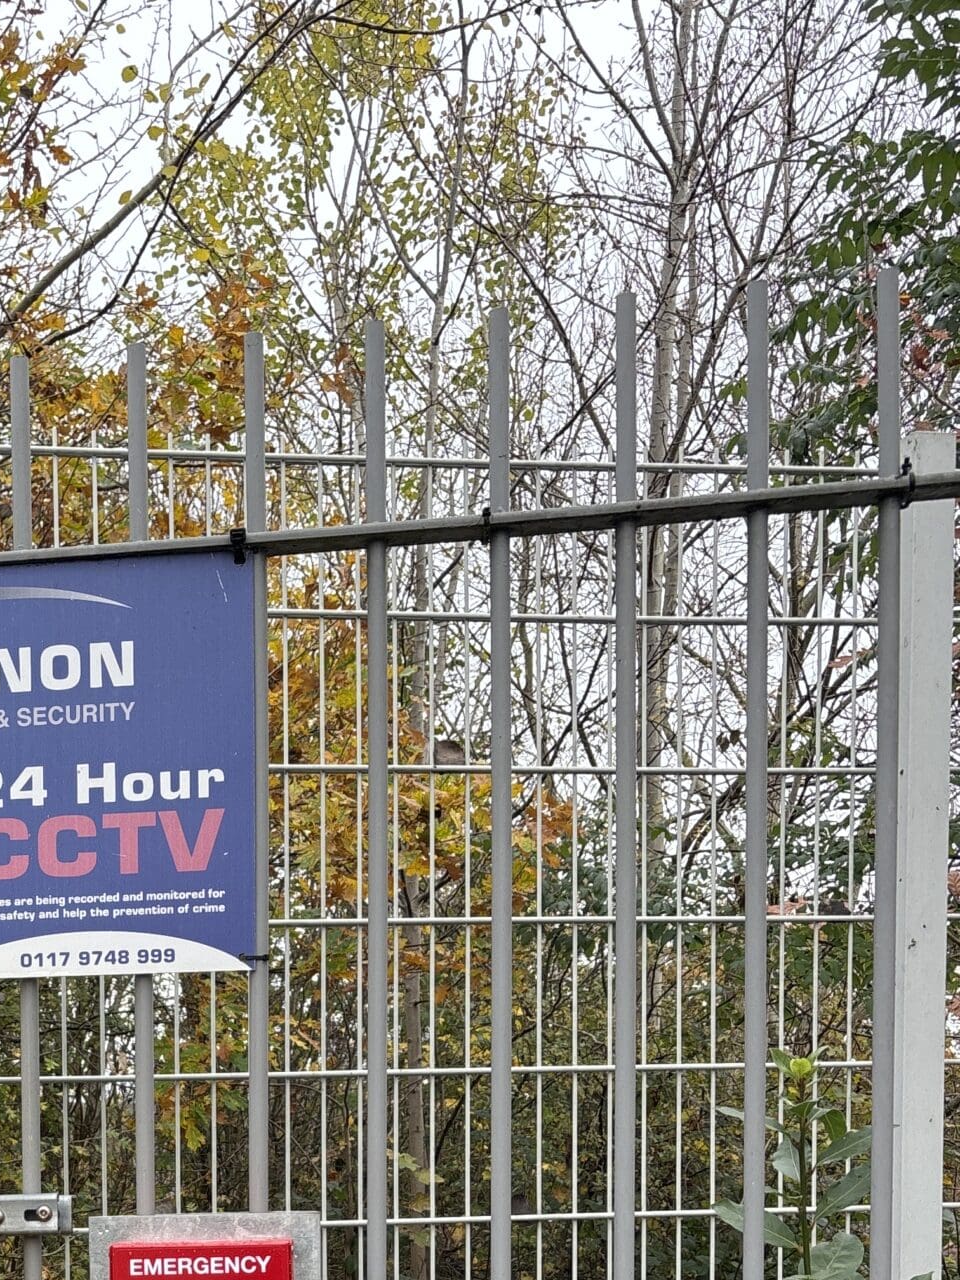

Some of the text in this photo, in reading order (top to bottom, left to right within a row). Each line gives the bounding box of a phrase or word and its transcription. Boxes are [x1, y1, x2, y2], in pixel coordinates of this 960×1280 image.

[16, 701, 135, 728] SECURITY
[77, 762, 225, 804] Hour
[14, 897, 33, 906] are
[35, 894, 66, 907] being
[68, 892, 120, 904] recorded
[122, 891, 144, 902] and
[146, 889, 205, 901] monitored
[207, 888, 226, 899] for
[0, 910, 36, 922] safety
[38, 909, 60, 920] and
[62, 908, 87, 919] help
[90, 907, 109, 917] the
[112, 904, 174, 917] prevention
[177, 903, 190, 914] of
[192, 903, 226, 914] crime
[20, 948, 176, 968] 0117 9748 999
[129, 1256, 271, 1276] EMERGENCY
